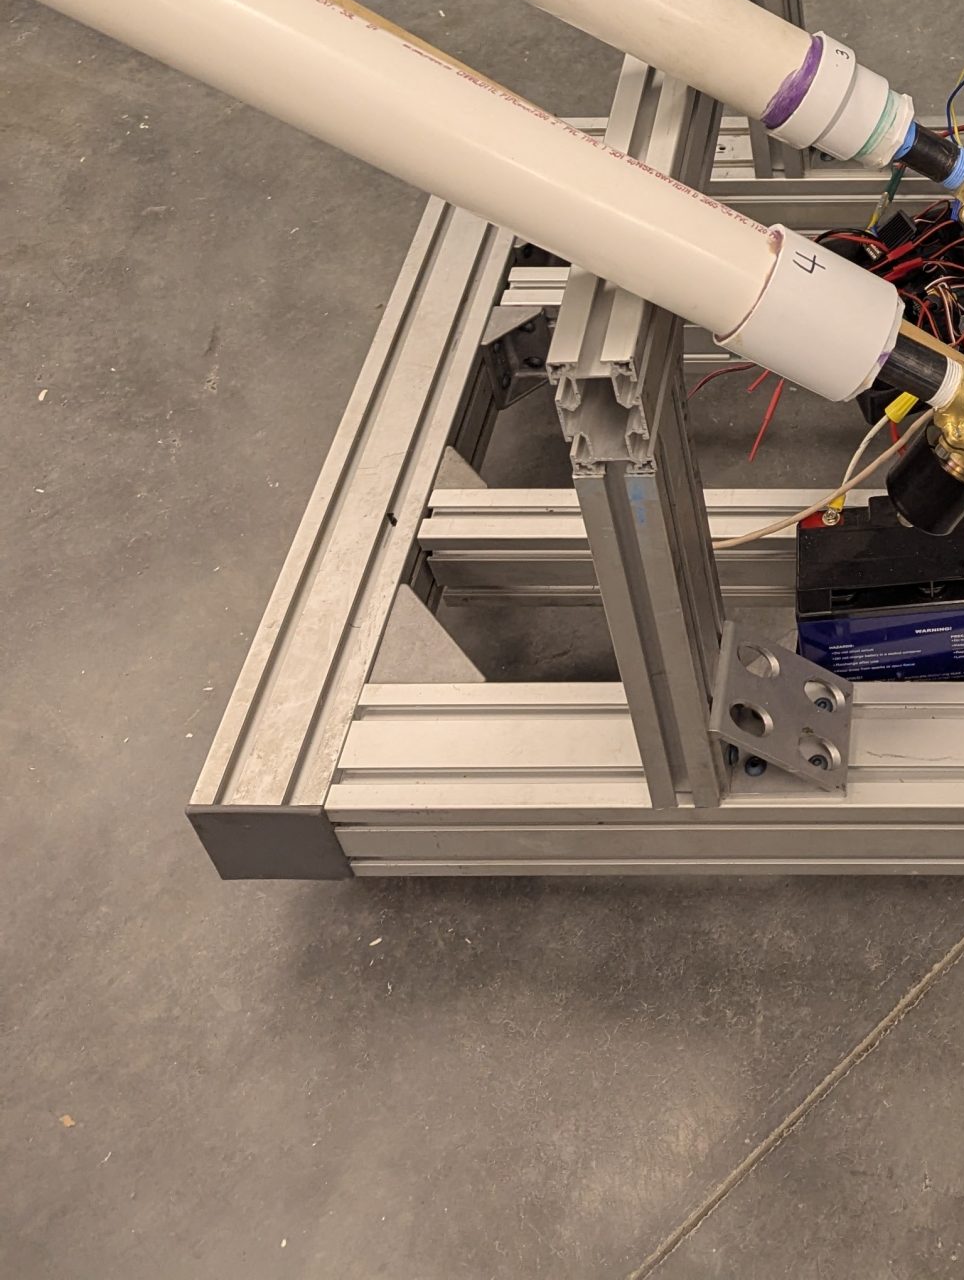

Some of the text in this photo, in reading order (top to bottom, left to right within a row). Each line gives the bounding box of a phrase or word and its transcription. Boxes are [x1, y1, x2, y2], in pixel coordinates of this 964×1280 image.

[835, 48, 850, 60] 3
[750, 222, 768, 235] 1120
[792, 251, 827, 274] 4
[914, 626, 953, 634] WARNING!
